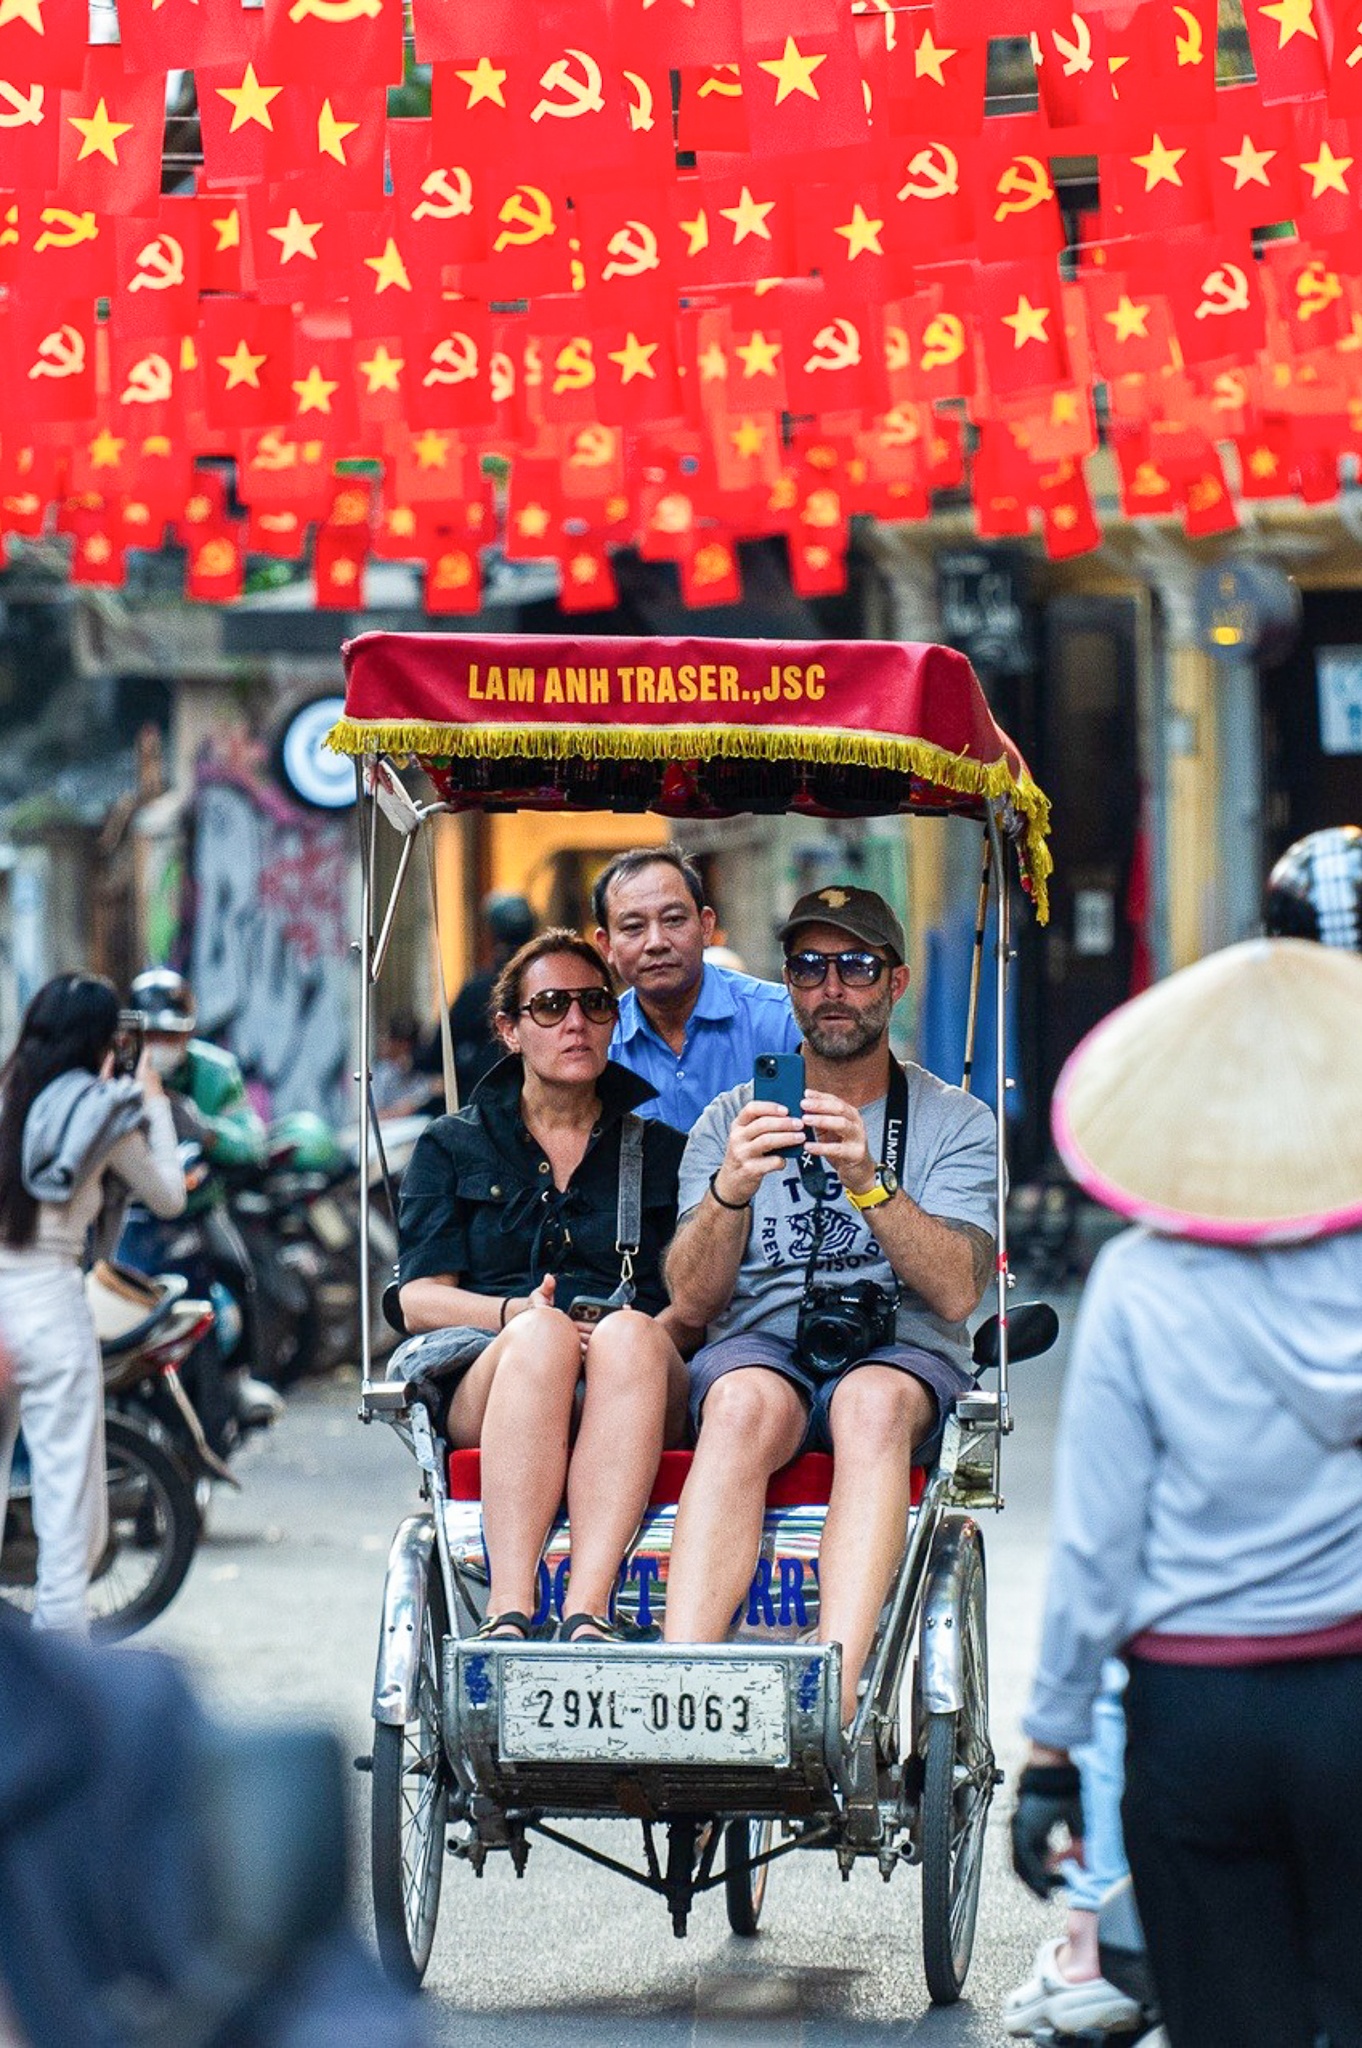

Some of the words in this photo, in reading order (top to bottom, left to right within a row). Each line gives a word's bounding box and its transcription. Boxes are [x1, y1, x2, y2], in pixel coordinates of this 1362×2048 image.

[468, 664, 535, 703] LAM
[543, 667, 609, 704] ANH
[886, 1118, 902, 1172] LUMIX
[762, 1216, 785, 1268] FREN
